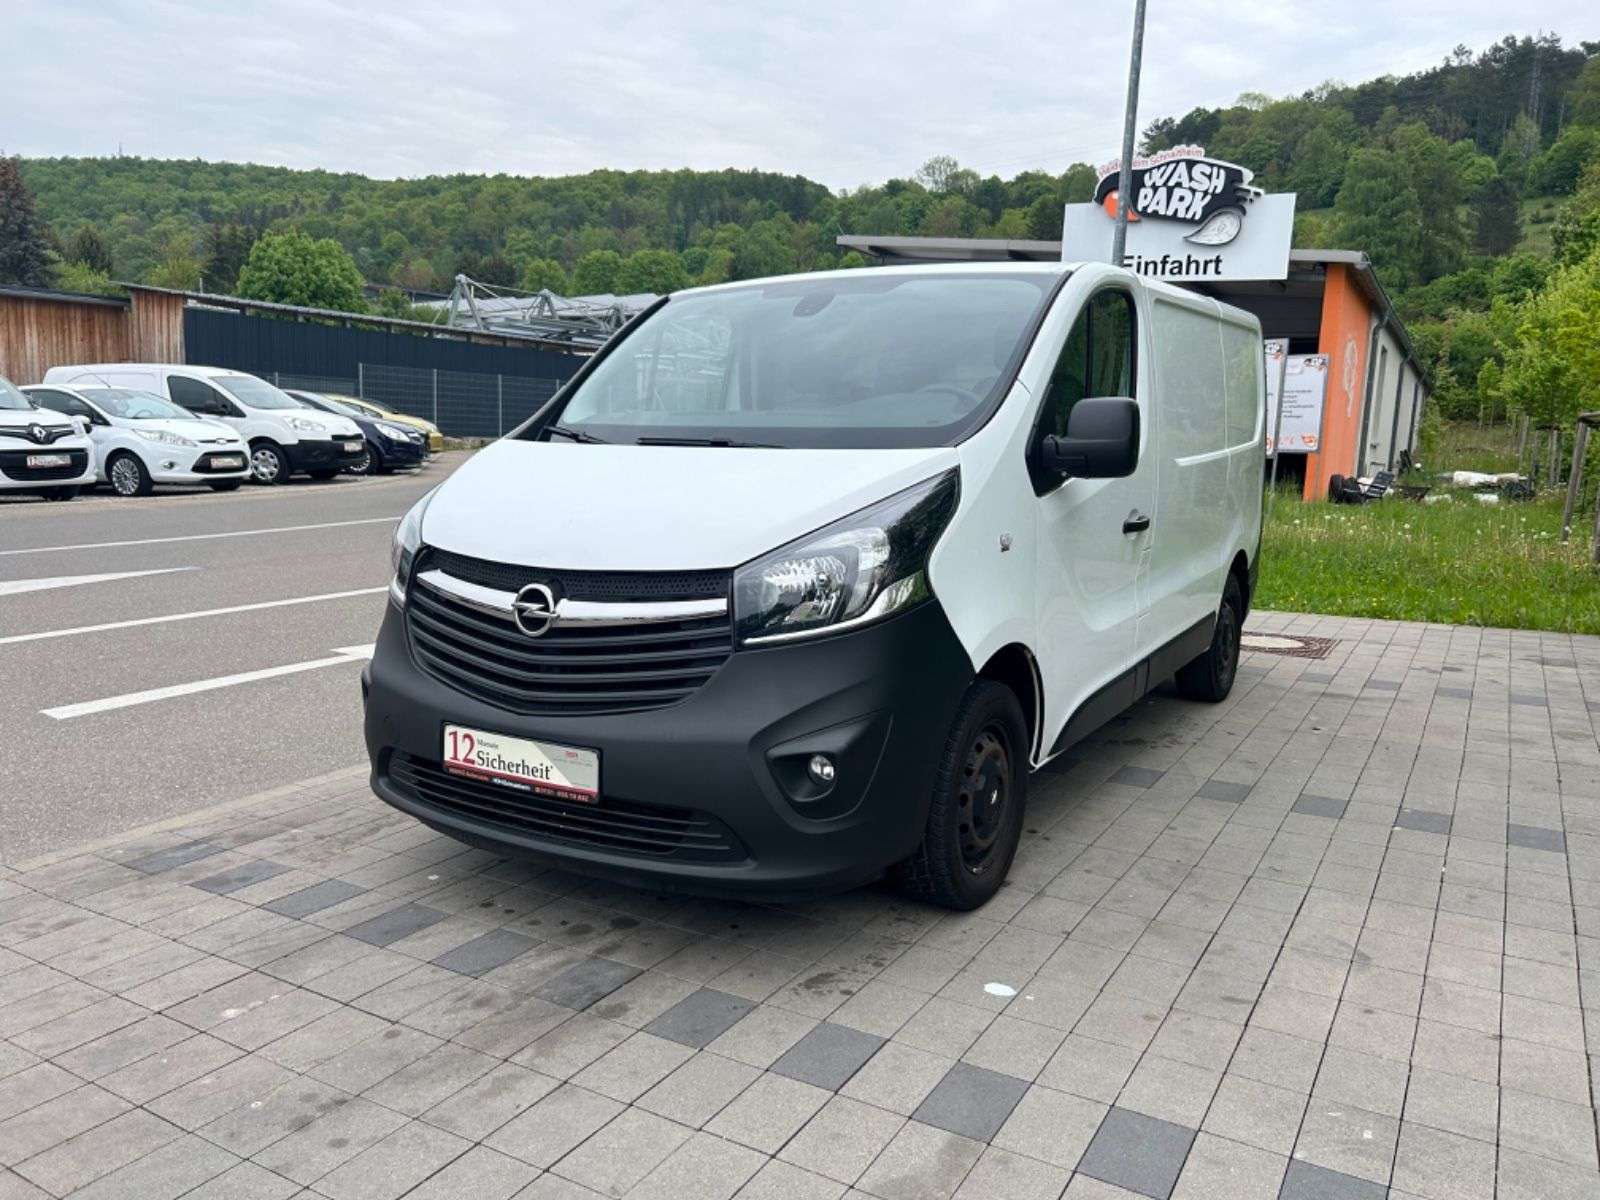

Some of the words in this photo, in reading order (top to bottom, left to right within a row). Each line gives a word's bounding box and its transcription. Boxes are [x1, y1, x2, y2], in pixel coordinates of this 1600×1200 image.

[1144, 161, 1225, 195] WASH
[1137, 186, 1212, 220] PARK
[448, 730, 476, 764] 12
